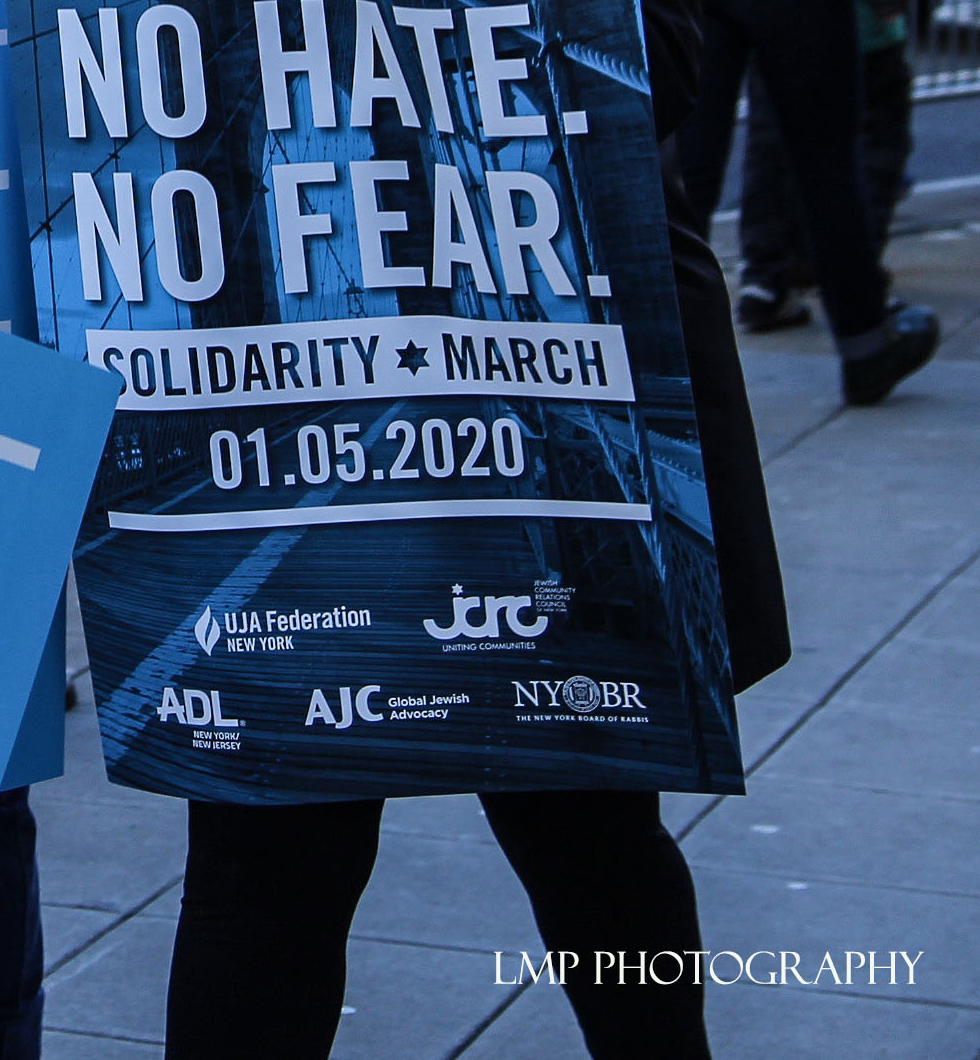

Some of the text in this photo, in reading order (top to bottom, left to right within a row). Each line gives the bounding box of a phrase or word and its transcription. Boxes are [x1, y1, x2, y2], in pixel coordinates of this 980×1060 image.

[57, 4, 207, 139] NO
[72, 160, 612, 302] NO FEAR.
[102, 332, 608, 398] SOLIDARITY MARCH
[209, 417, 525, 490] 01.05.2020
[224, 606, 371, 634] UJA Federation
[227, 635, 295, 653] NEW YORK
[442, 642, 536, 652] UNITING COMMUNITIES
[305, 685, 384, 729] AJC
[388, 693, 470, 707] Global Jewish
[389, 709, 448, 720] Advocacy
[192, 739, 241, 750] NEW JERSEY
[193, 730, 212, 739] NEW
